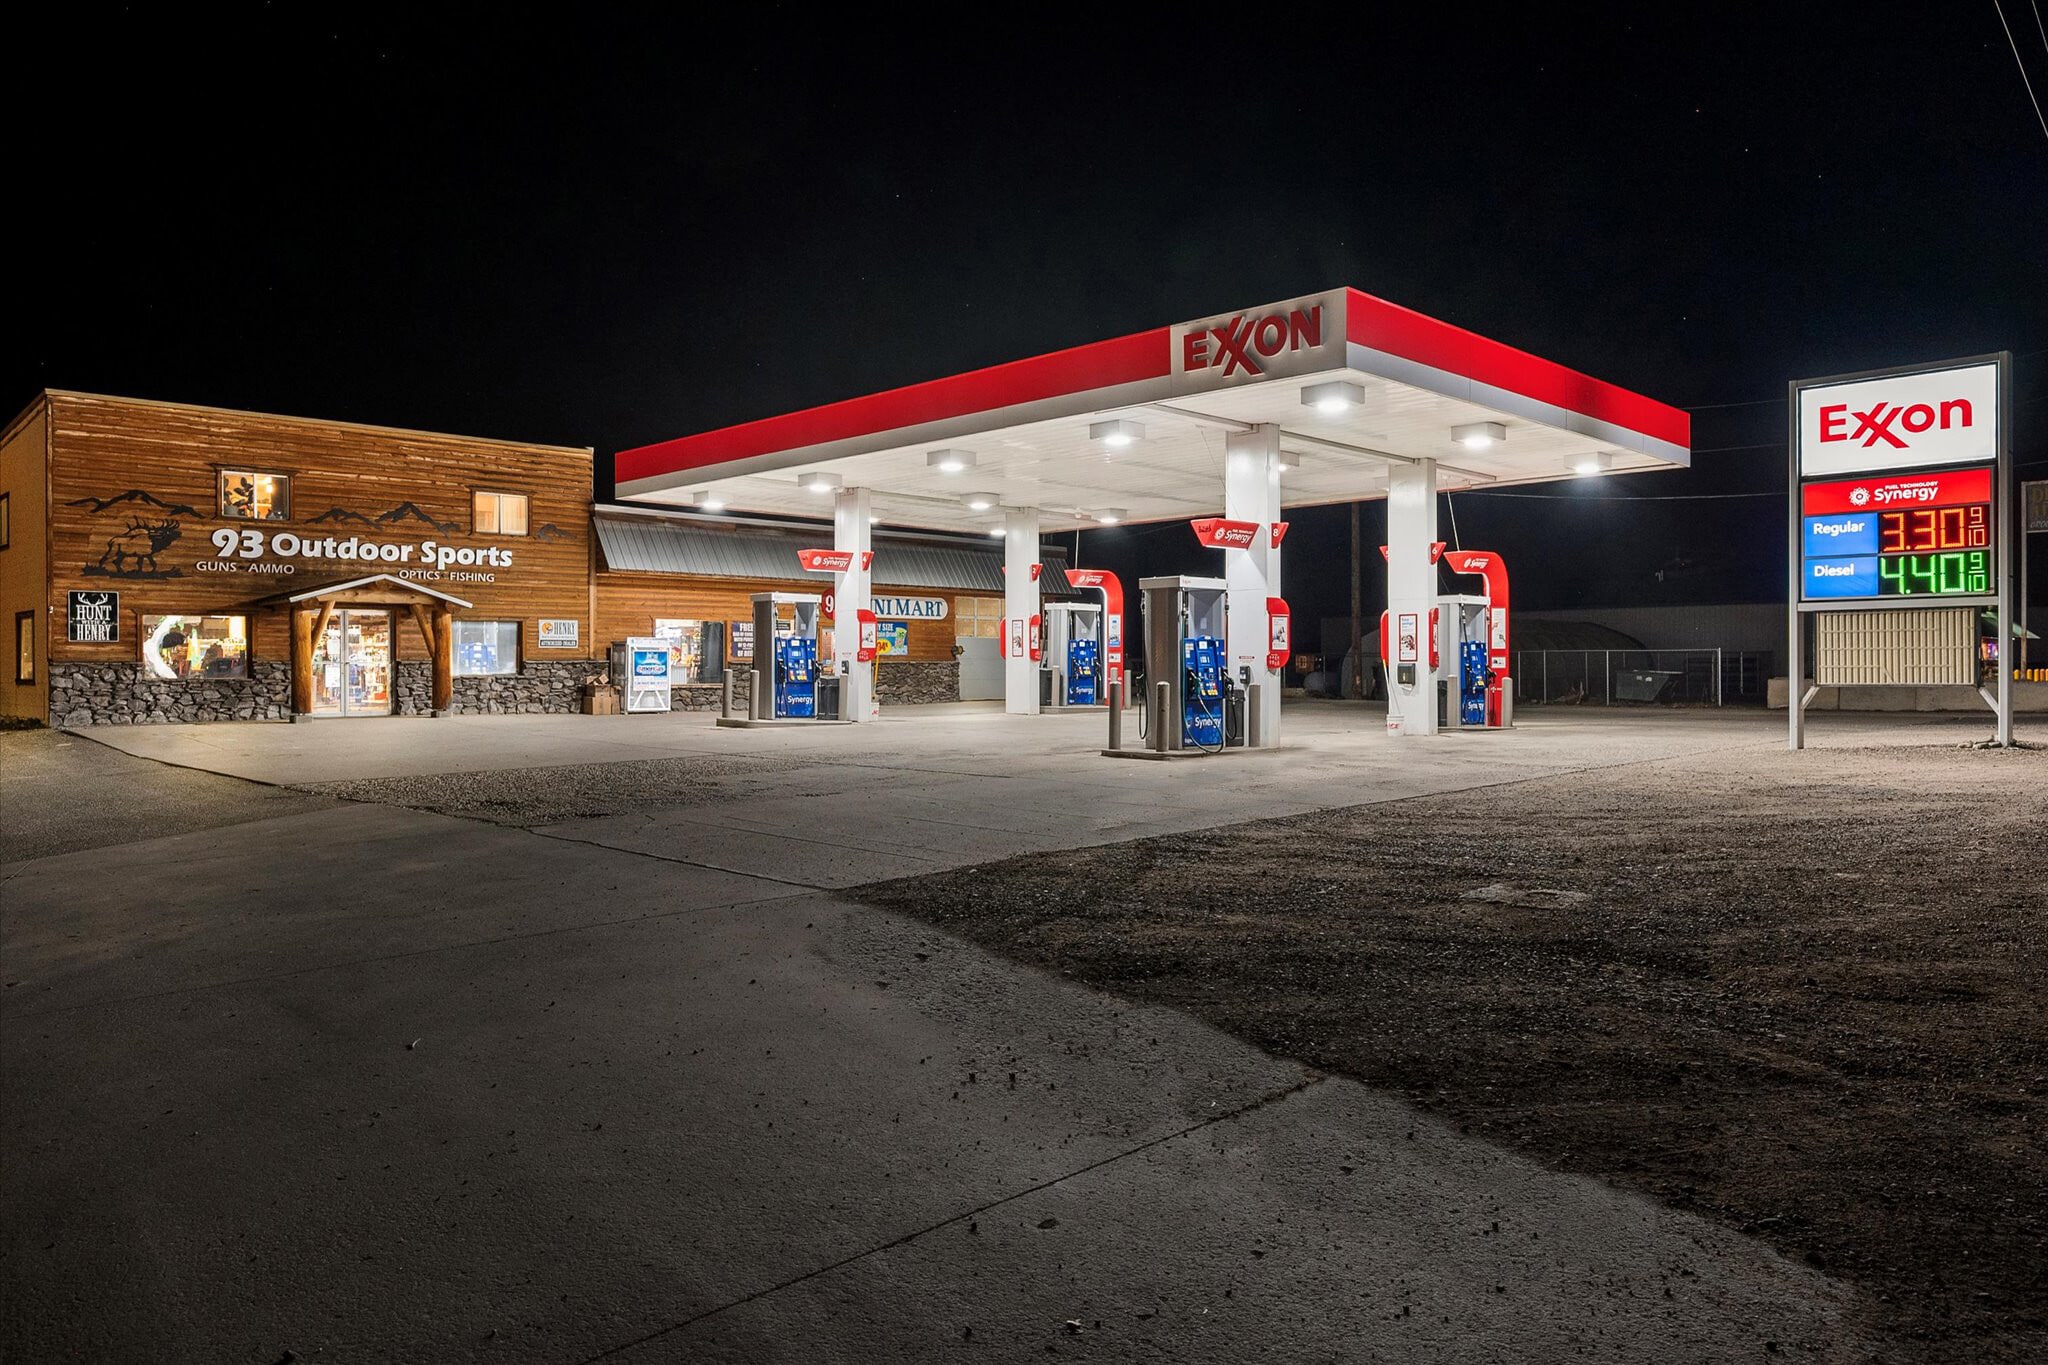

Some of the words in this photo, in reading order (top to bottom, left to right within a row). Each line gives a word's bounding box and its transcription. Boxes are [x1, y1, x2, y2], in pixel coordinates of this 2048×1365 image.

[1183, 305, 1323, 378] EXXON
[1820, 398, 1973, 448] Exxon
[1900, 480, 1939, 489] TECHNOLOGY
[1874, 487, 1939, 504] Synergy
[1272, 528, 1279, 537] 8
[1813, 521, 1865, 537] Regular
[1225, 530, 1252, 544] Synergy
[212, 528, 264, 558] 93
[271, 533, 414, 562] Outdoor
[420, 541, 513, 570] Sports
[196, 561, 237, 572] GUNS
[248, 563, 295, 574] AMMO
[822, 558, 849, 568] Synergy
[1814, 563, 1855, 577] Diesel
[399, 570, 441, 580] OPTICS
[450, 572, 495, 582] FISHING
[825, 595, 835, 613] 9
[871, 598, 892, 615] NI
[895, 599, 943, 617] MART
[76, 604, 112, 620] HUNT
[76, 624, 111, 641] HENRY
[553, 621, 576, 635] HENRY
[787, 695, 813, 704] Synergy
[1194, 716, 1221, 729] Synergy
